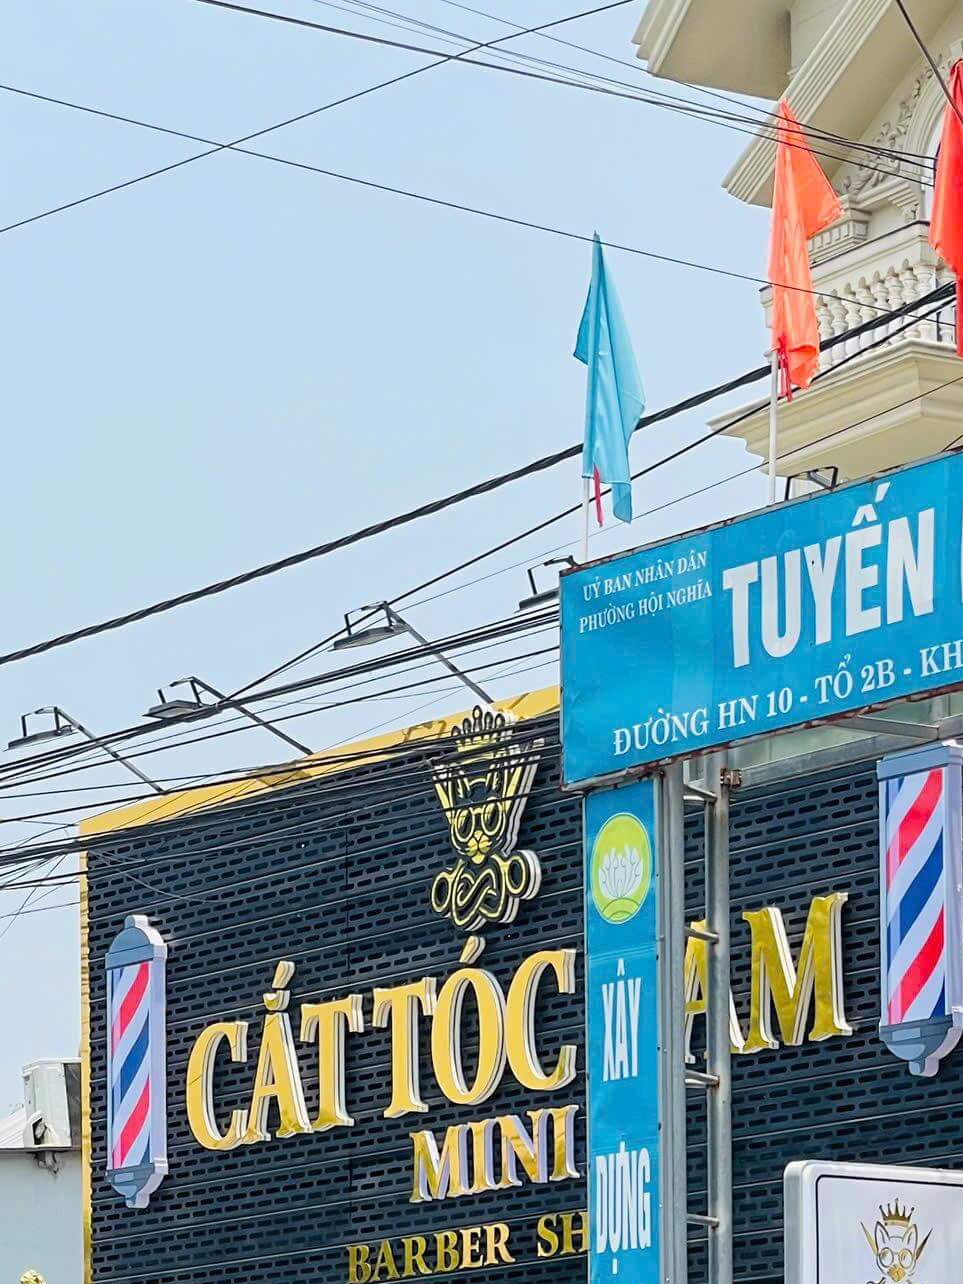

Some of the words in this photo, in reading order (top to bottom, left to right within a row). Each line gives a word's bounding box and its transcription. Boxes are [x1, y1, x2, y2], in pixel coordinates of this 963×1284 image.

[578, 603, 635, 633] PHƯỜNG
[639, 592, 663, 617] HỘI
[604, 572, 632, 595] BAN
[634, 559, 674, 586] NHÂN
[677, 550, 707, 574] DÂN
[723, 483, 935, 667] TUYẾN
[613, 697, 709, 756] ĐƯỜNG
[716, 692, 760, 732] HN
[766, 688, 793, 717] 10
[815, 653, 853, 704] TỔ
[861, 658, 896, 691] 2B
[186, 961, 364, 1151] CẮT
[373, 936, 578, 1119] TÓC
[684, 891, 854, 1063] AM
[601, 958, 641, 1083] XÂY
[409, 1105, 580, 1204] MINI
[595, 1137, 652, 1275] DỰNG
[346, 1222, 515, 1284] BARBER
[537, 1211, 590, 1257] SH
